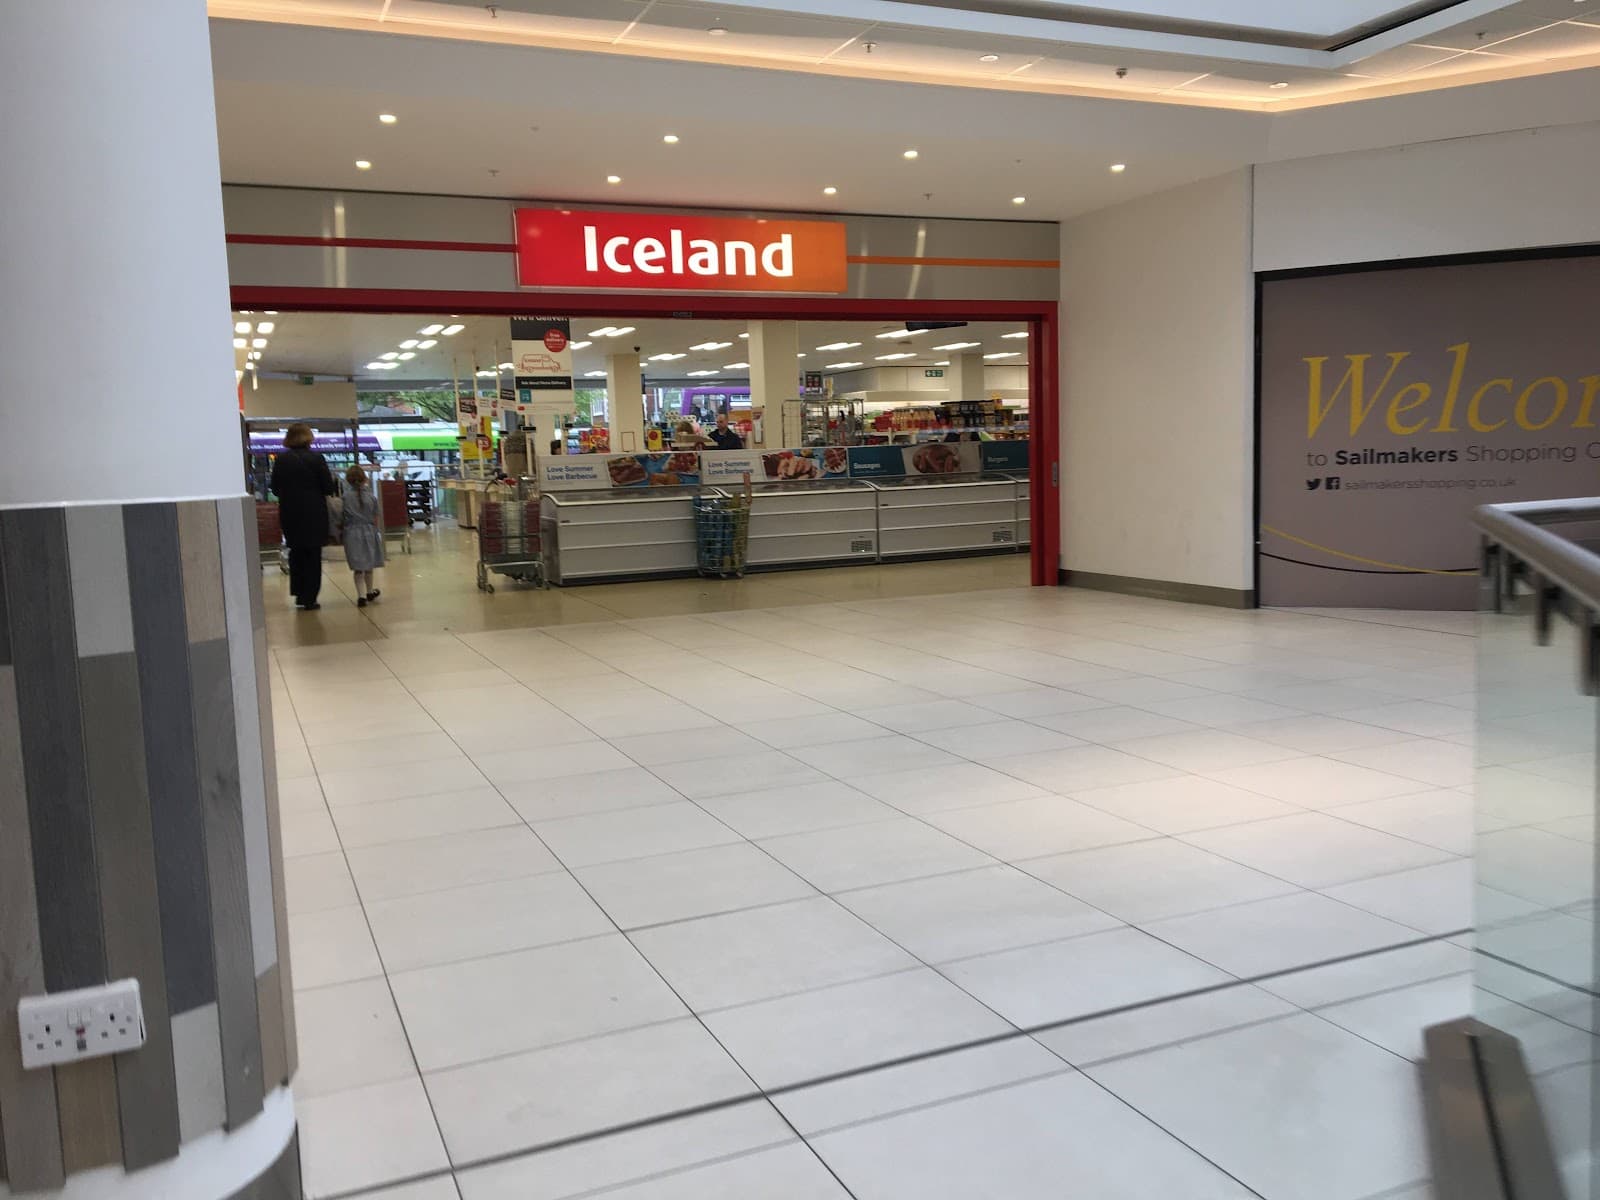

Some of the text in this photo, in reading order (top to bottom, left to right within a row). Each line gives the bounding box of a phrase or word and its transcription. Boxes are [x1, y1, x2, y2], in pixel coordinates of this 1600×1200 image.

[584, 225, 794, 277] Iceland
[1306, 452, 1328, 467] to
[1335, 447, 1458, 465] Sailmakers
[1466, 442, 1577, 463] Shopping
